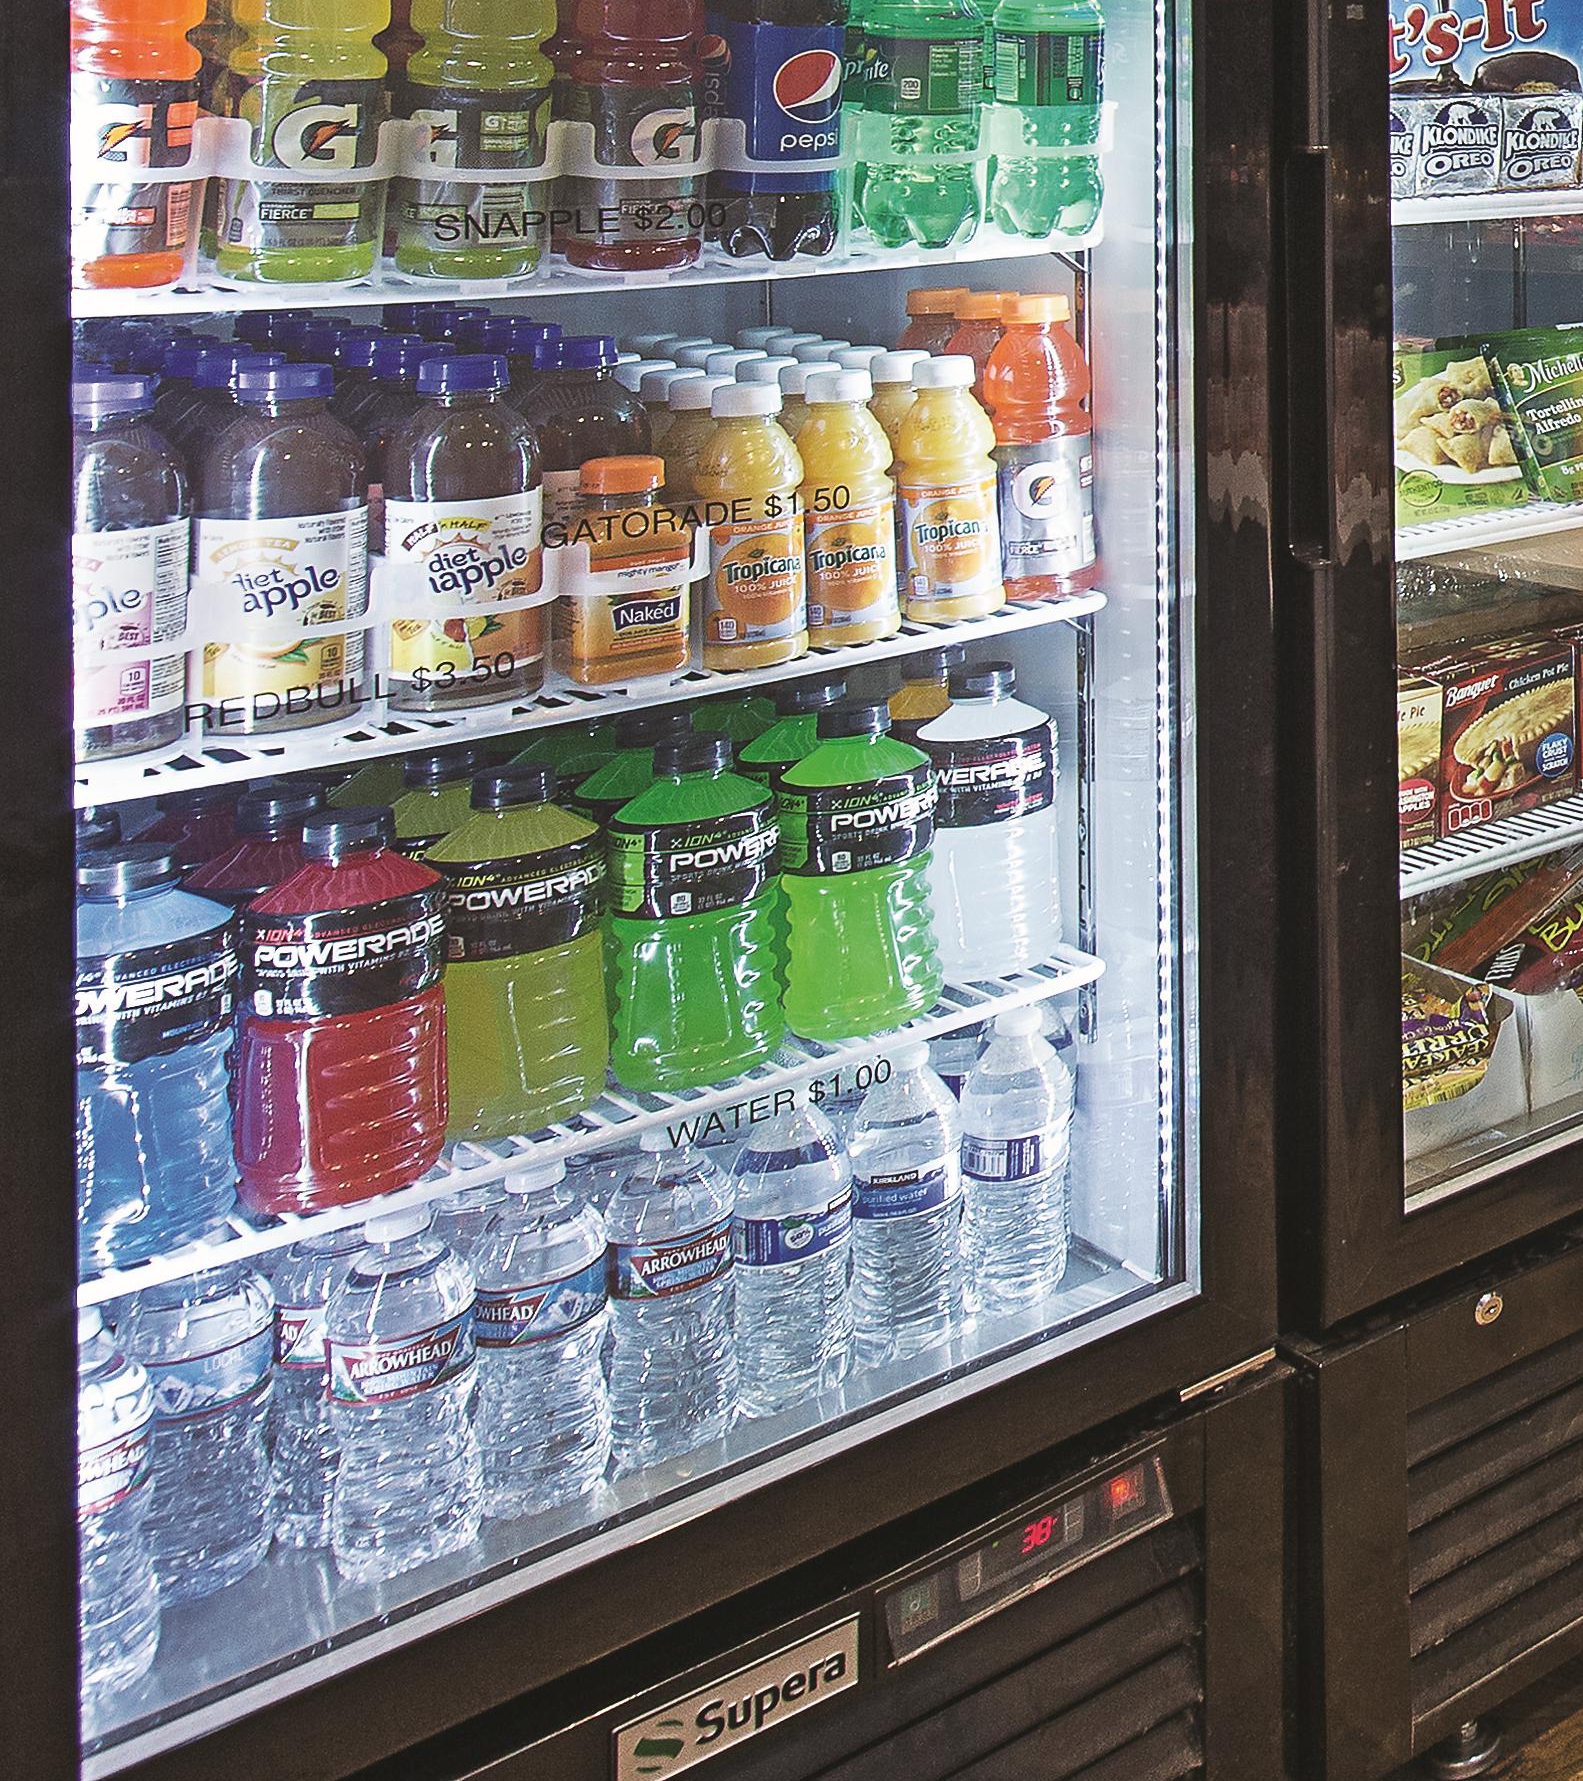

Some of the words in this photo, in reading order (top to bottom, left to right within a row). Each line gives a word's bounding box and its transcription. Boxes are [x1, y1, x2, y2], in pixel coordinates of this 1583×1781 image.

[779, 130, 838, 155] pepsi
[1421, 124, 1498, 154] KLONDIKE
[1505, 129, 1579, 159] KLONDIKE
[433, 204, 620, 243] SNAPPLE
[634, 203, 727, 233] $2.00
[1535, 413, 1581, 435] Alfredo
[541, 498, 752, 549] GATORADE
[764, 485, 851, 519] $1.50
[429, 548, 481, 573] diet
[723, 556, 801, 584] Tropicana
[810, 545, 886, 572] Tropicana
[620, 603, 674, 625] Naked
[184, 673, 399, 732] REDBULL
[412, 651, 514, 691] $3.50
[1446, 676, 1498, 706] Banquet
[254, 913, 445, 970] POWERADE
[667, 1089, 797, 1150] WATER
[808, 1059, 892, 1106] $1.00
[641, 1235, 727, 1277] ARROWHEAD
[351, 1339, 455, 1382] ARROWHEAD
[695, 1649, 847, 1746] Supera
